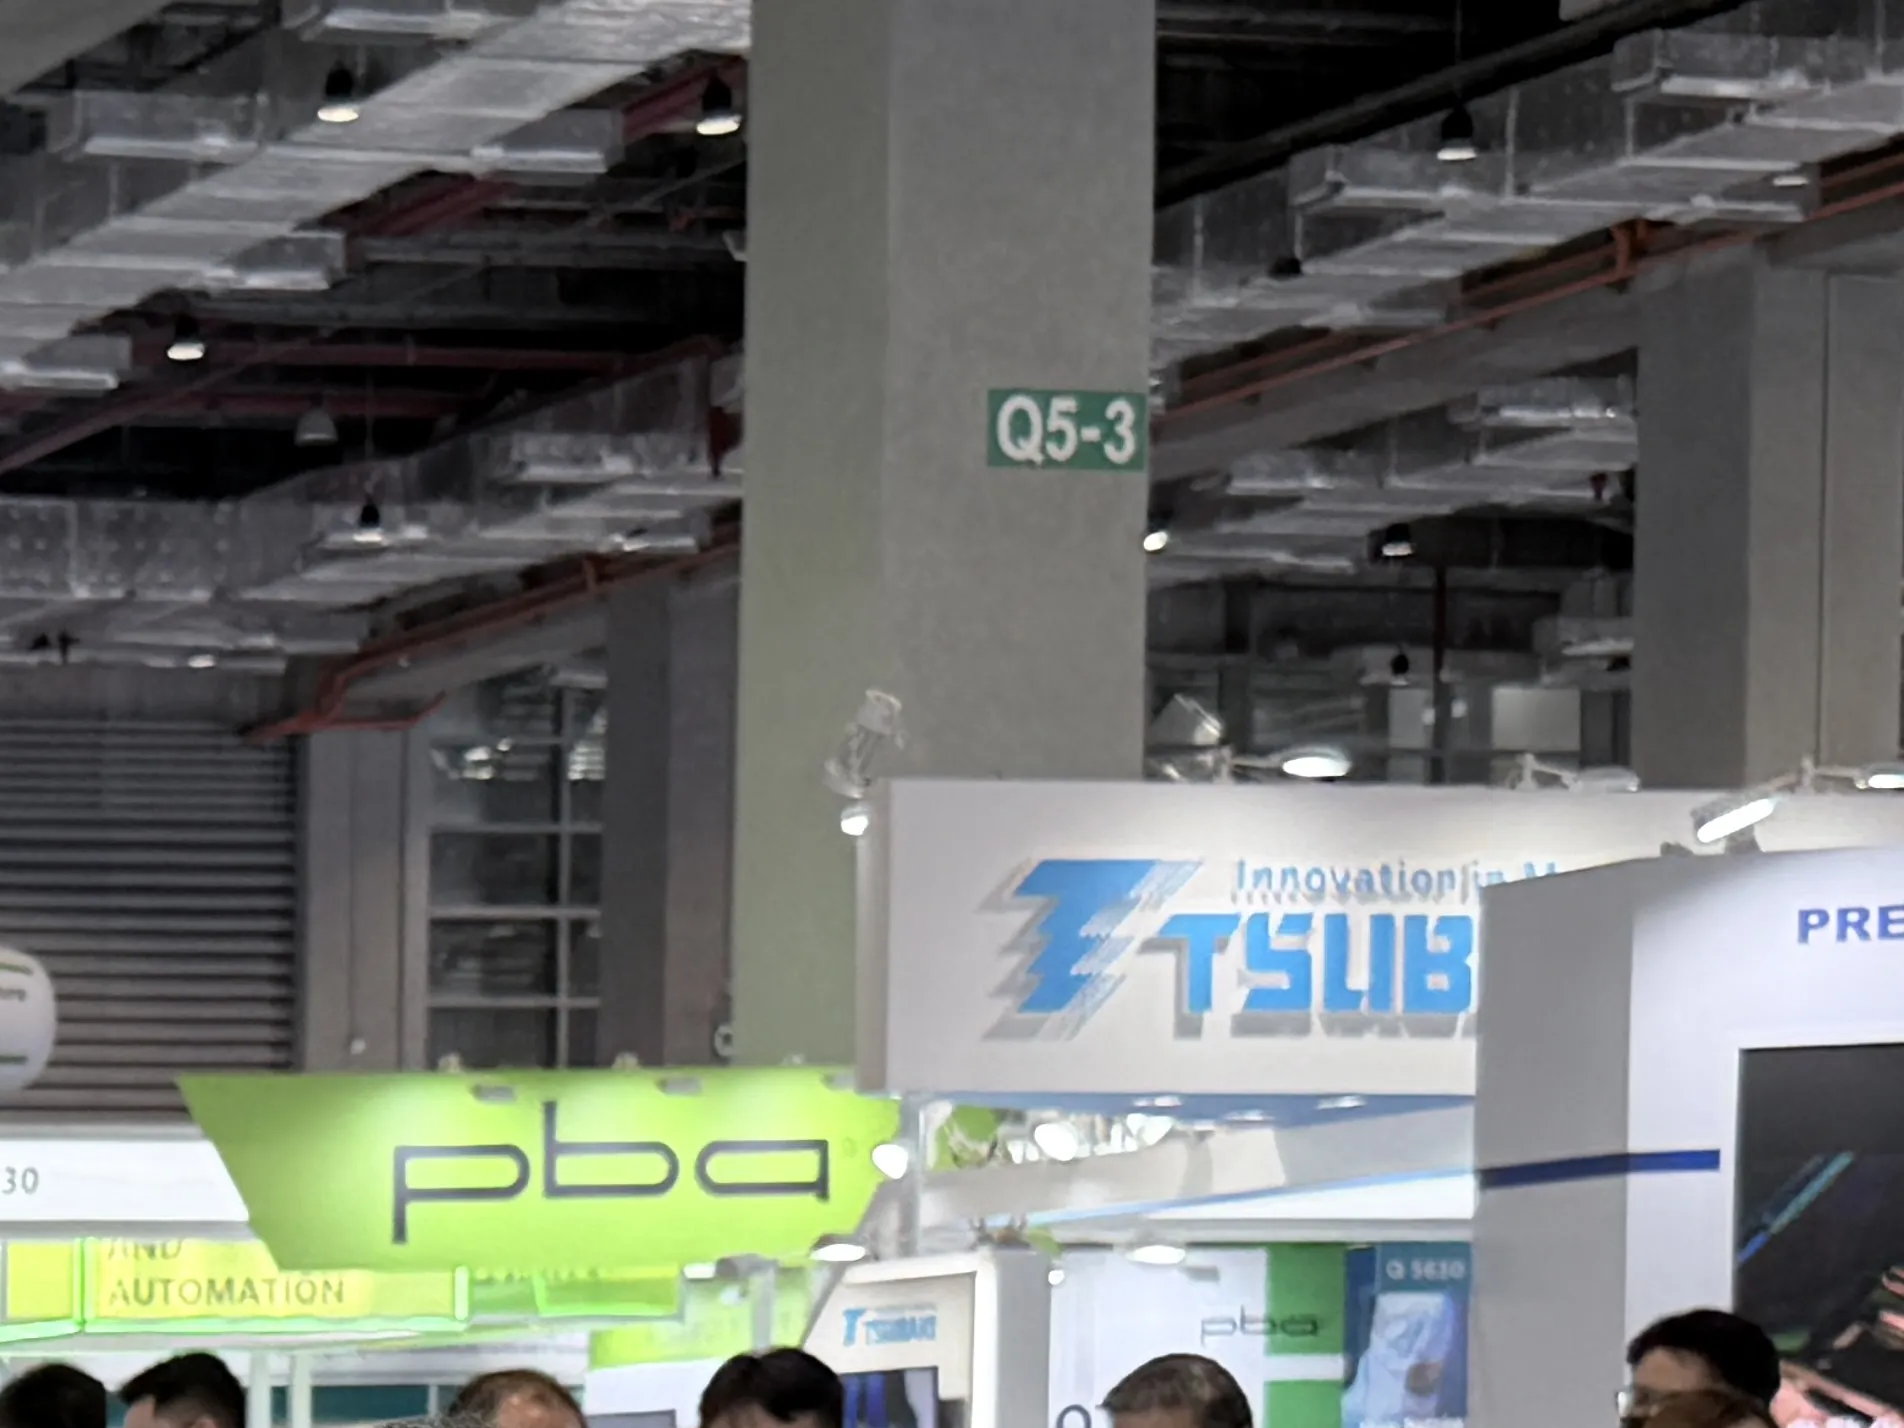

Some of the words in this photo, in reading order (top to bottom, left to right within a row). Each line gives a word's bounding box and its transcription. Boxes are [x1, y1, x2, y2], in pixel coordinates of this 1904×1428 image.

[996, 394, 1135, 465] Q5-3
[1236, 859, 1457, 894] Innovation
[392, 1101, 830, 1245] pba
[108, 1275, 345, 1307] AUTOMATION
